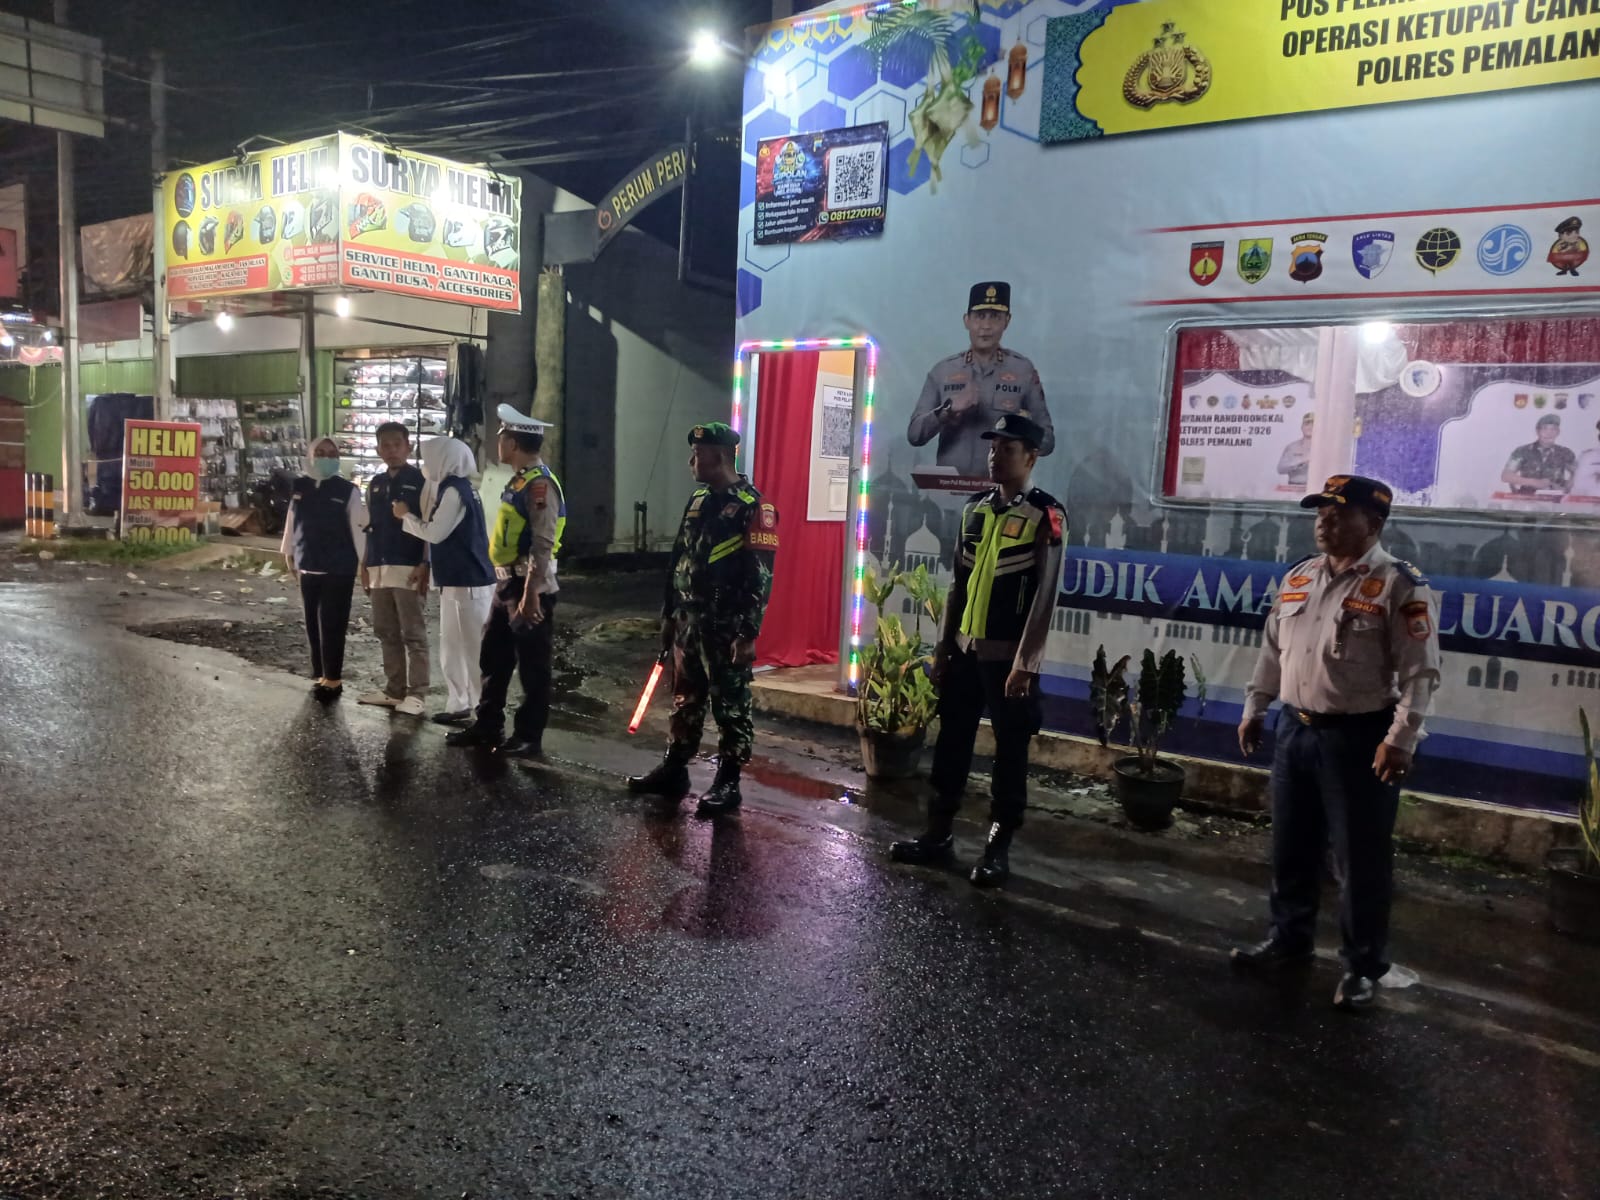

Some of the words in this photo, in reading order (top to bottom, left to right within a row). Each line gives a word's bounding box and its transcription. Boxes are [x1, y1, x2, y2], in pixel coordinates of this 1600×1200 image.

[1281, 0, 1329, 21] POS
[1282, 18, 1390, 58] OPERASI
[1396, 0, 1519, 43] KETUPAT
[1357, 49, 1455, 87] POLRES
[1462, 27, 1600, 74] PEMALAN
[200, 161, 263, 211] SURYA
[351, 143, 441, 199] SURYA
[446, 166, 514, 217] HELM
[611, 168, 656, 219] PERUM
[830, 206, 882, 222] 0811270110
[346, 250, 399, 268] SERVICE
[402, 258, 439, 276] HELM,
[444, 266, 479, 282] GANTI
[351, 266, 391, 282] GANTI
[395, 274, 433, 289] BUSA,
[437, 280, 513, 301] ACCESSORIES
[130, 428, 197, 457] HELM
[1206, 438, 1253, 447] PEMALANG
[1214, 426, 1241, 435] CANDI
[1248, 426, 1272, 435] 2026
[129, 470, 194, 491] 50.000
[128, 495, 151, 510] JAS
[153, 496, 195, 511] HUJAN
